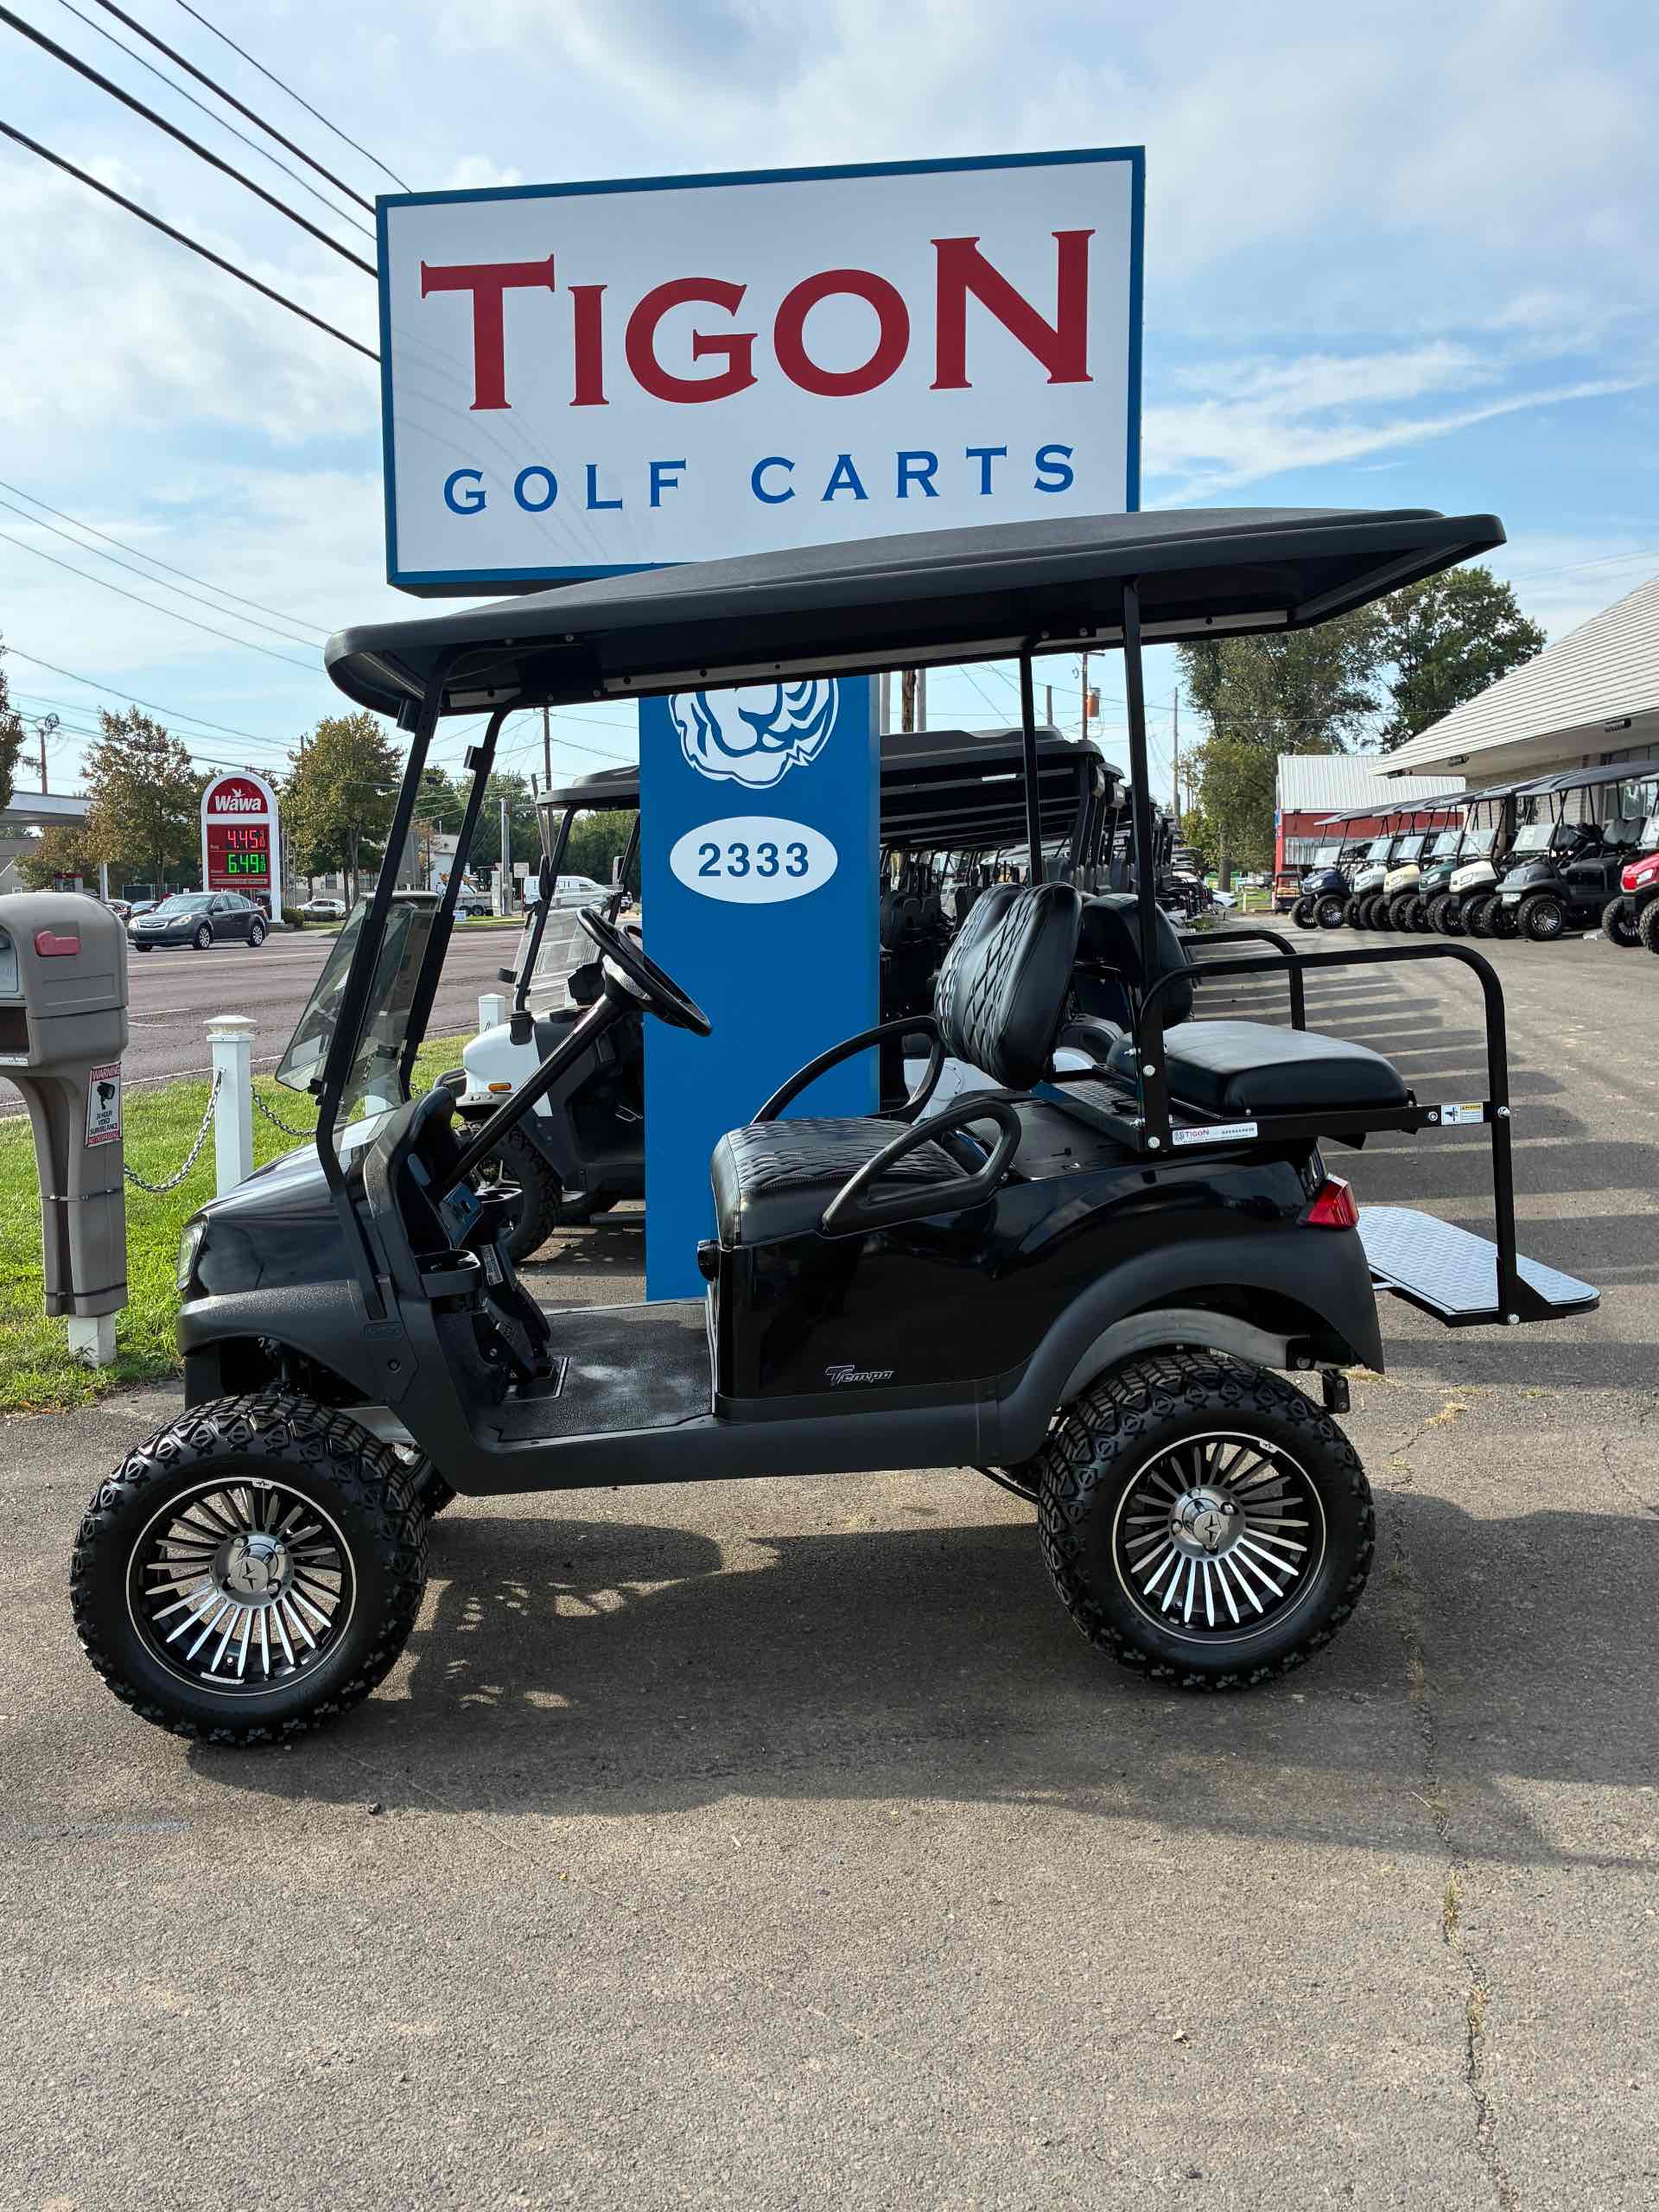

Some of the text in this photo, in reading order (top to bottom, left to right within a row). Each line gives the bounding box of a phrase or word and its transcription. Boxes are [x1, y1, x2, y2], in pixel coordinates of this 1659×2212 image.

[420, 229, 1096, 410] TIGON
[443, 444, 1075, 515] GOLF CARTS
[214, 795, 262, 811] Wawa
[698, 842, 809, 877] 2333
[92, 1065, 120, 1080] WARNING
